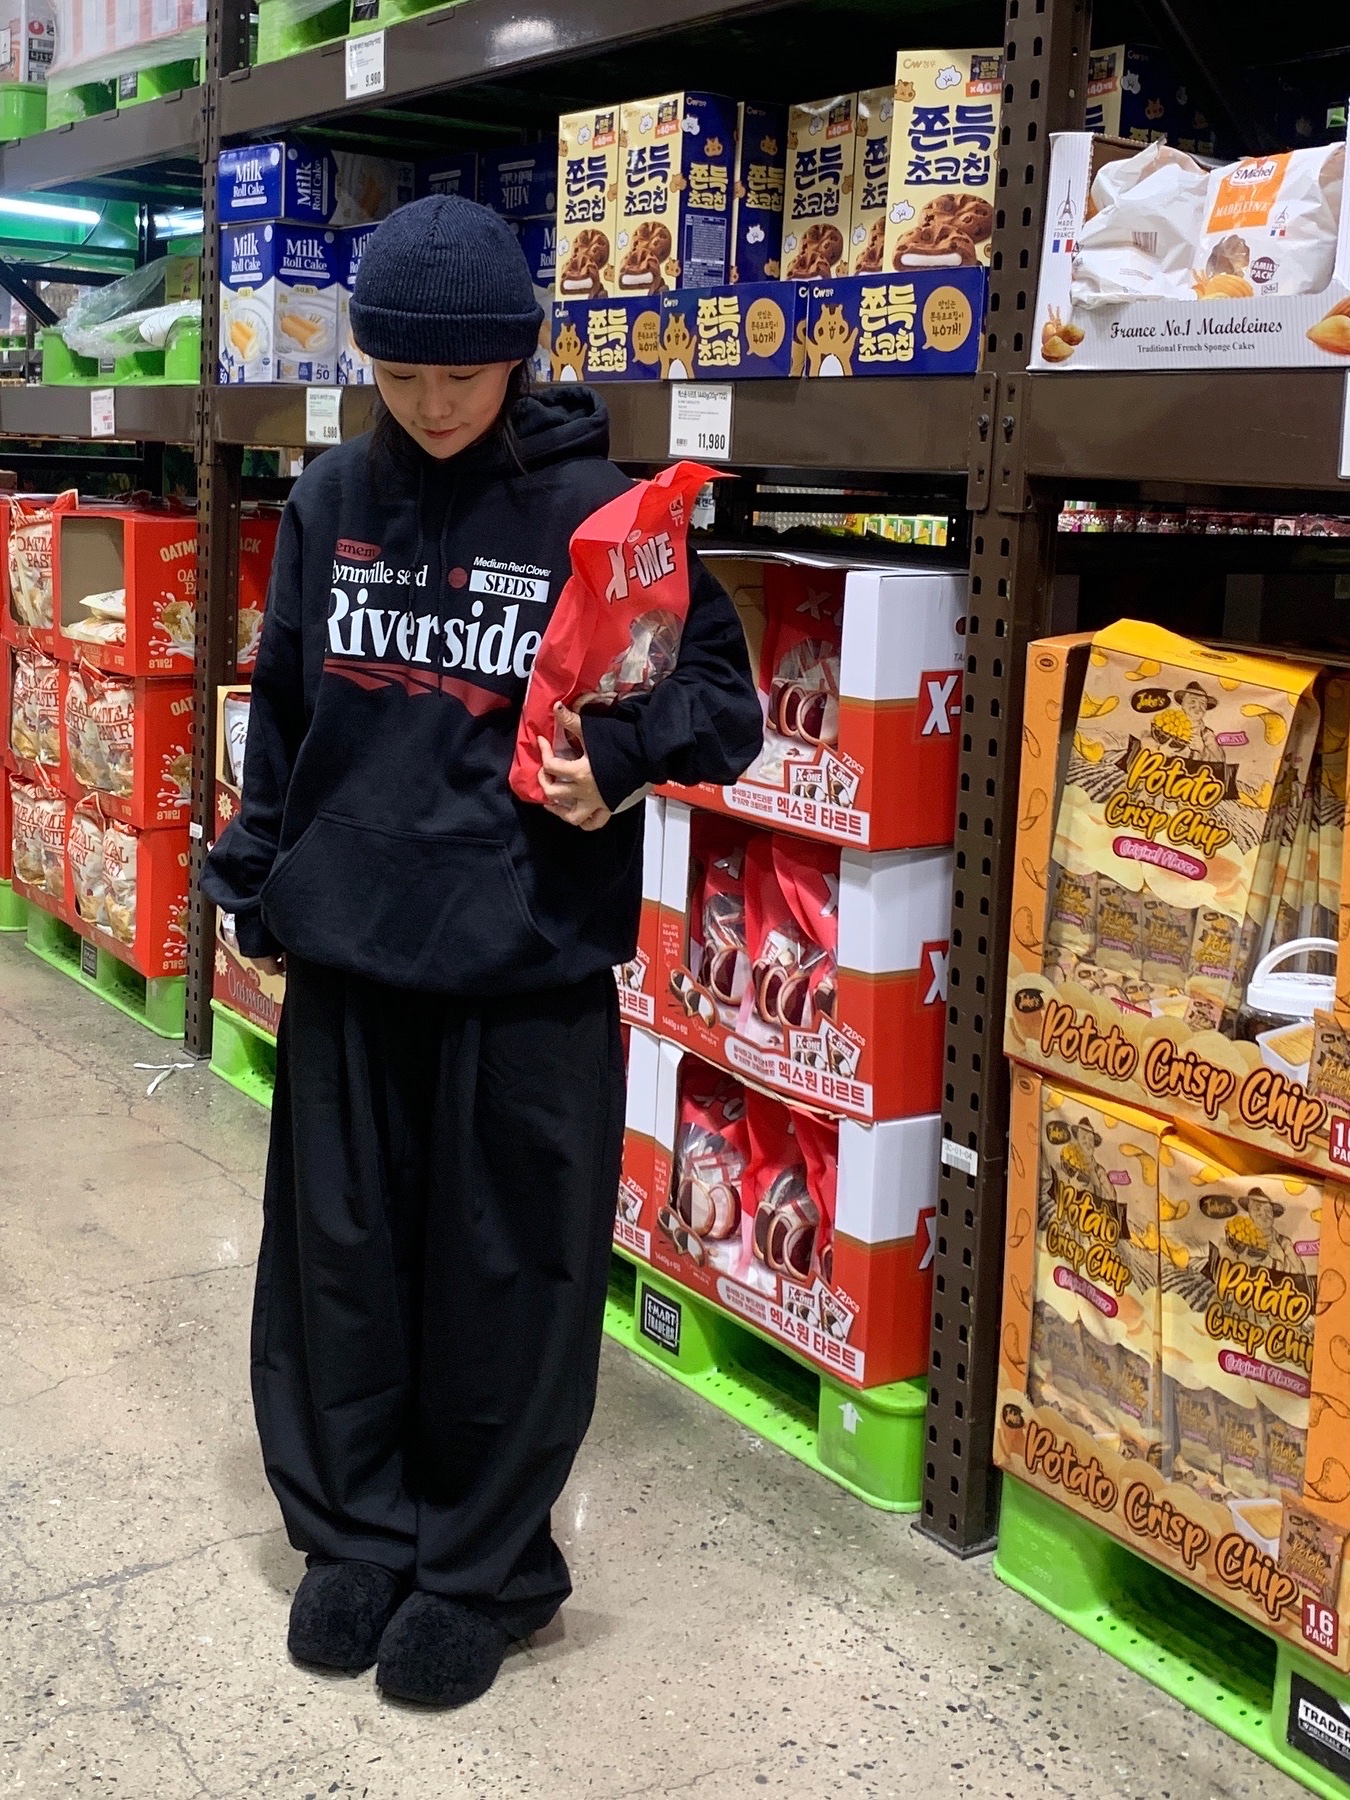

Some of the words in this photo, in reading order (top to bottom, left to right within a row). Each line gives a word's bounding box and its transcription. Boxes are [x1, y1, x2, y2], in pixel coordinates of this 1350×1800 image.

[907, 103, 997, 153] 쫀득
[235, 159, 263, 183] Milk
[312, 160, 322, 186] Cake
[565, 153, 608, 198] 쫀득
[625, 143, 671, 188] 쫀득
[687, 162, 729, 191] 쫀득
[747, 162, 785, 191] 쫀득
[794, 143, 844, 191] 쫀득
[904, 152, 991, 186] 초코칩
[233, 184, 247, 197] Roll
[247, 182, 265, 195] Cake
[296, 162, 312, 206] Milk
[312, 190, 322, 211] Roll
[564, 194, 606, 224] 초코칩
[623, 185, 668, 217] 초코칩
[687, 190, 727, 212] 초코칩
[745, 190, 783, 213] 초코칩
[791, 187, 840, 220] 초코칩
[233, 232, 260, 257] Milk
[286, 239, 324, 259] Milk
[1053, 231, 1075, 239] FRANCE
[231, 258, 244, 273] Roll
[244, 257, 261, 272] Cake
[283, 256, 302, 268] Roll
[303, 259, 328, 271] Cake
[1250, 270, 1274, 281] PACK
[697, 295, 741, 338] 쫀득
[858, 282, 918, 332] 쫀득
[587, 307, 629, 347] 쫀득
[931, 322, 962, 337] 40개!
[1110, 322, 1157, 339] France
[1161, 318, 1191, 337] No.1
[1197, 316, 1283, 336] Madeleines
[587, 343, 628, 373] 초코칩
[697, 334, 741, 367] 초코칩
[858, 327, 914, 363] 초코칩
[1137, 344, 1176, 353] Traditional
[1177, 343, 1203, 352] French
[1204, 343, 1231, 353] Sponge
[1232, 341, 1256, 351] Cakes
[315, 368, 330, 380] 50
[698, 433, 726, 451] 11,980
[671, 514, 685, 528] 72
[473, 556, 508, 570] Medium
[508, 561, 527, 573] Red
[525, 564, 552, 577] Clover
[604, 530, 677, 605] X-ONE
[483, 573, 536, 599] SEEDS
[326, 587, 544, 679] Riverside
[796, 768, 823, 783] X-ONE
[827, 758, 855, 787] X-ONE
[841, 751, 865, 775] 72pcs
[1127, 748, 1225, 808] Potato
[776, 796, 816, 826] 엑스원
[820, 806, 862, 837] 타르트
[1105, 791, 1169, 842] Crisp
[1167, 808, 1232, 858] Chip
[1120, 839, 1161, 863] Original
[1161, 851, 1200, 875] Flavor
[796, 1034, 822, 1052] X-ONE
[841, 1022, 866, 1047] 72pcs
[778, 1061, 818, 1094] 엑스원
[821, 1076, 865, 1108] 타르트
[1041, 999, 1138, 1080] Potato
[1144, 1037, 1234, 1118] Crisp
[1239, 1067, 1327, 1150] Chip
[626, 1176, 648, 1199] 72pcs
[1057, 1180, 1120, 1247] Potato
[1047, 1220, 1086, 1273] Crisp
[1085, 1243, 1133, 1297] Chip
[788, 1286, 816, 1307] X-ONE
[834, 1286, 861, 1314] 72pcs
[1217, 1257, 1311, 1324] Potato
[769, 1306, 810, 1347] 엑스원
[813, 1332, 857, 1373] 타르트
[1205, 1302, 1265, 1355] Crisp
[1224, 1353, 1265, 1382] Original
[1266, 1366, 1306, 1392] Flavor
[1025, 1420, 1118, 1512] Potato
[1123, 1481, 1211, 1571] Crisp
[1214, 1532, 1299, 1622] Chip
[1292, 1539, 1327, 1569] Potato
[1306, 1603, 1334, 1637] 16
[1305, 1625, 1334, 1650] PACK
[1303, 1704, 1350, 1744] TRADER
